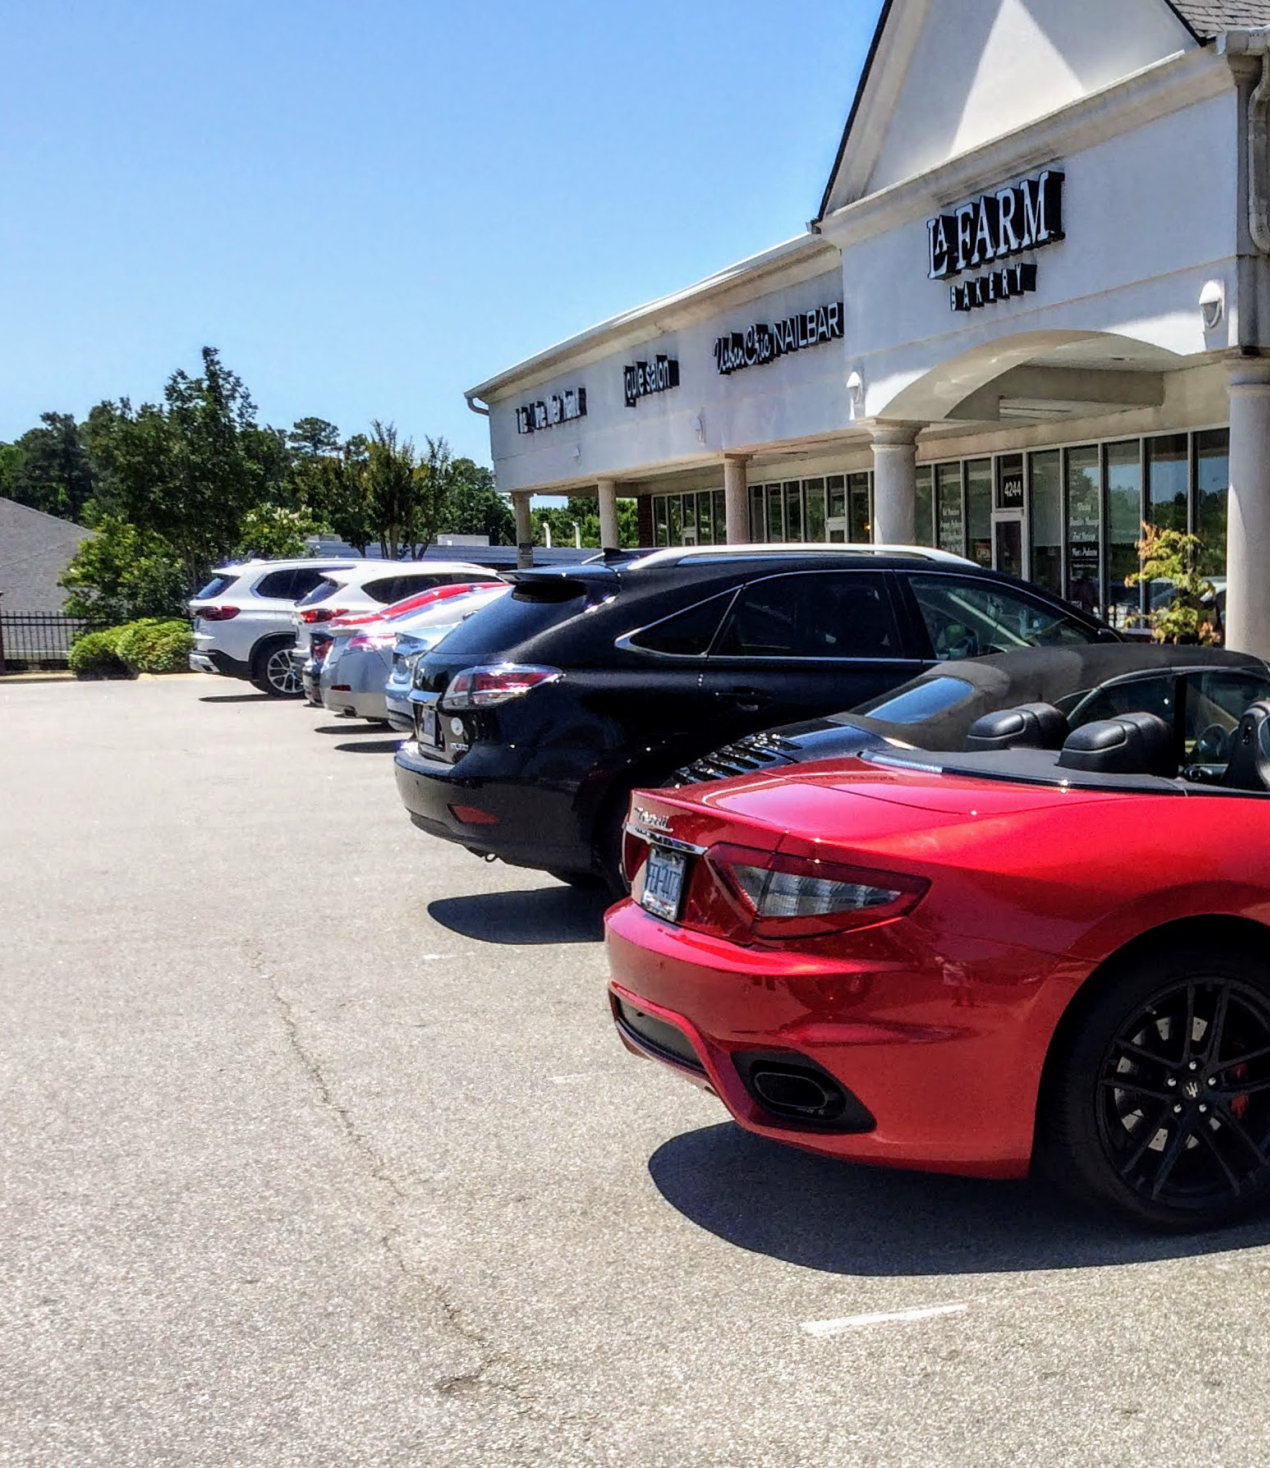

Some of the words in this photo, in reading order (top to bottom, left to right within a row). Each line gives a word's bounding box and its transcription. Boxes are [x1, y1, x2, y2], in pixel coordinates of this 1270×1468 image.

[926, 214, 949, 280] LA
[954, 169, 1051, 270] FARM
[950, 262, 1023, 311] BAKERY
[1004, 480, 1021, 497] 4244
